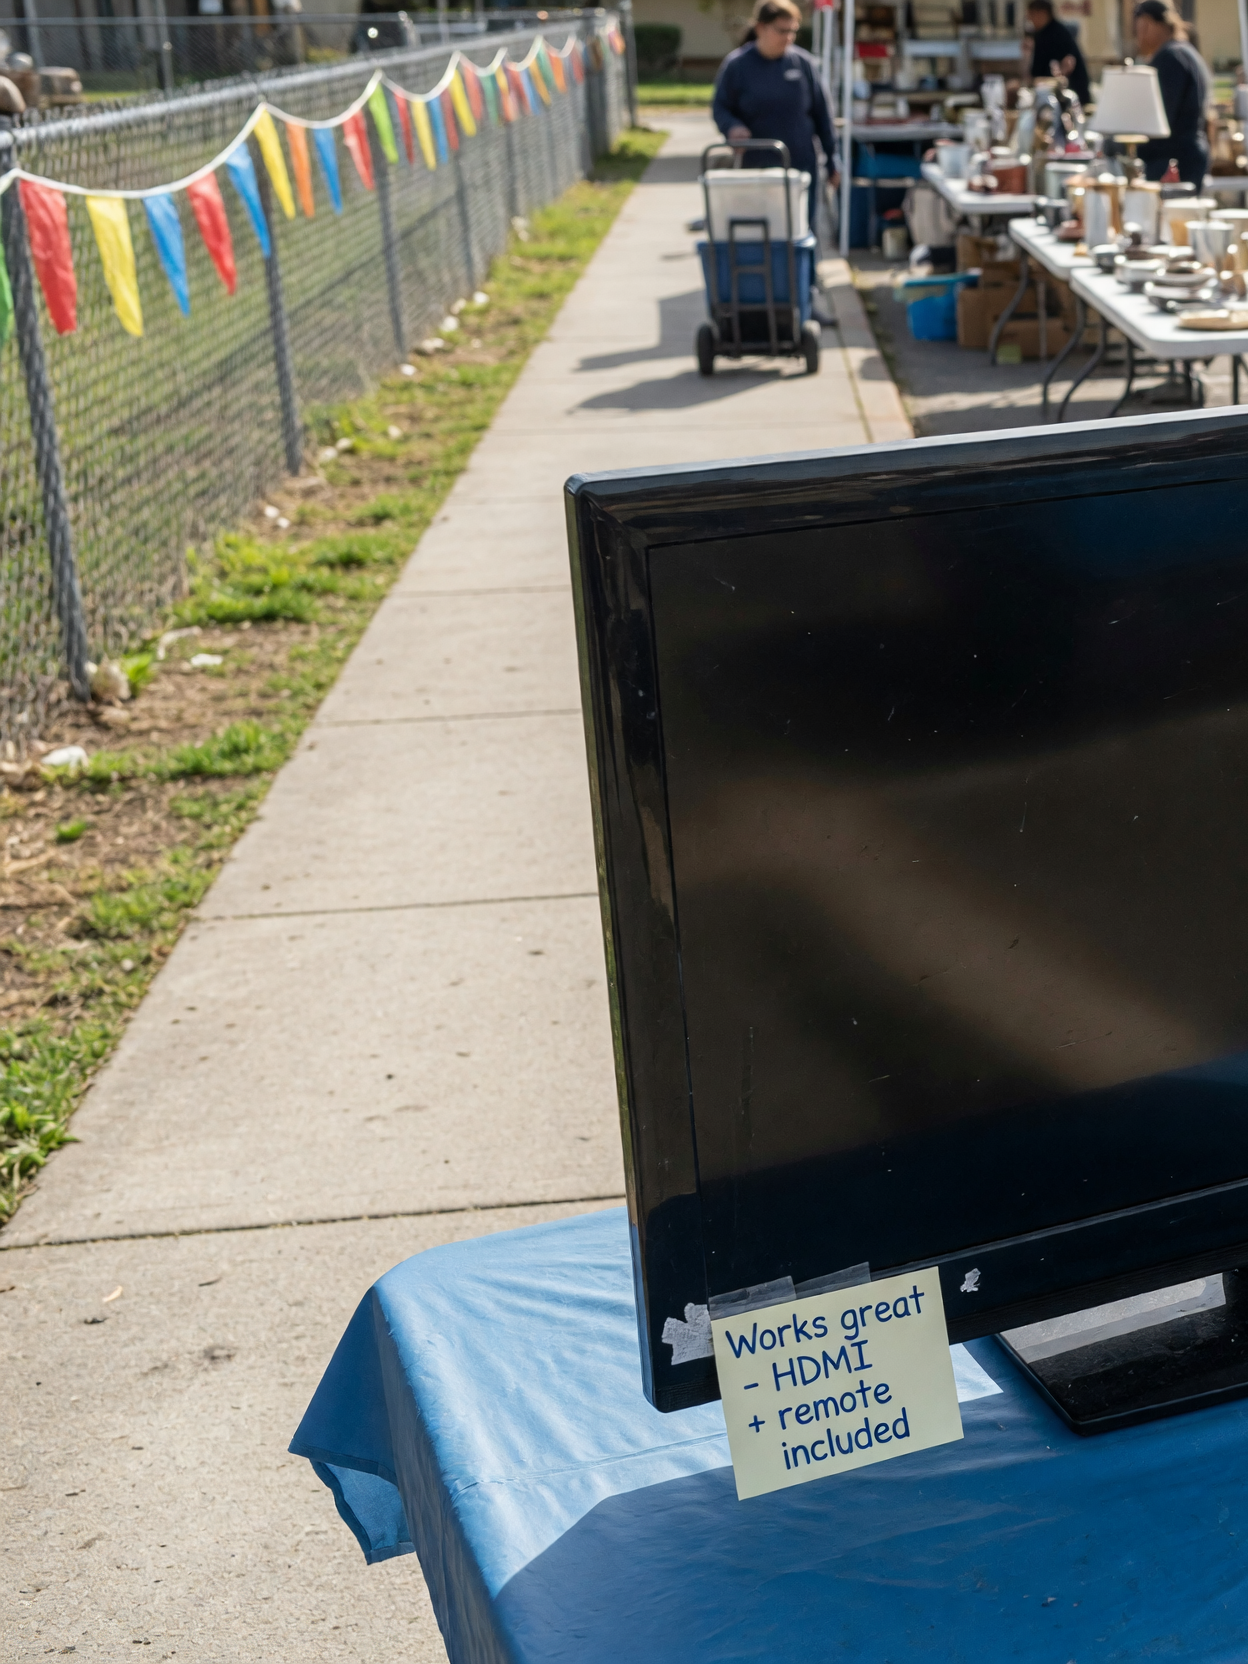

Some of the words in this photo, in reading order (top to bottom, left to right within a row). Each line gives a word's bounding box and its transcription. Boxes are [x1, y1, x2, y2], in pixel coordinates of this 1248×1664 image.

[725, 1313, 828, 1358] Works
[840, 1285, 925, 1340] great
[772, 1339, 873, 1391] HDMI
[748, 1415, 765, 1433] +
[778, 1379, 892, 1430] remote
[781, 1406, 910, 1470] included
